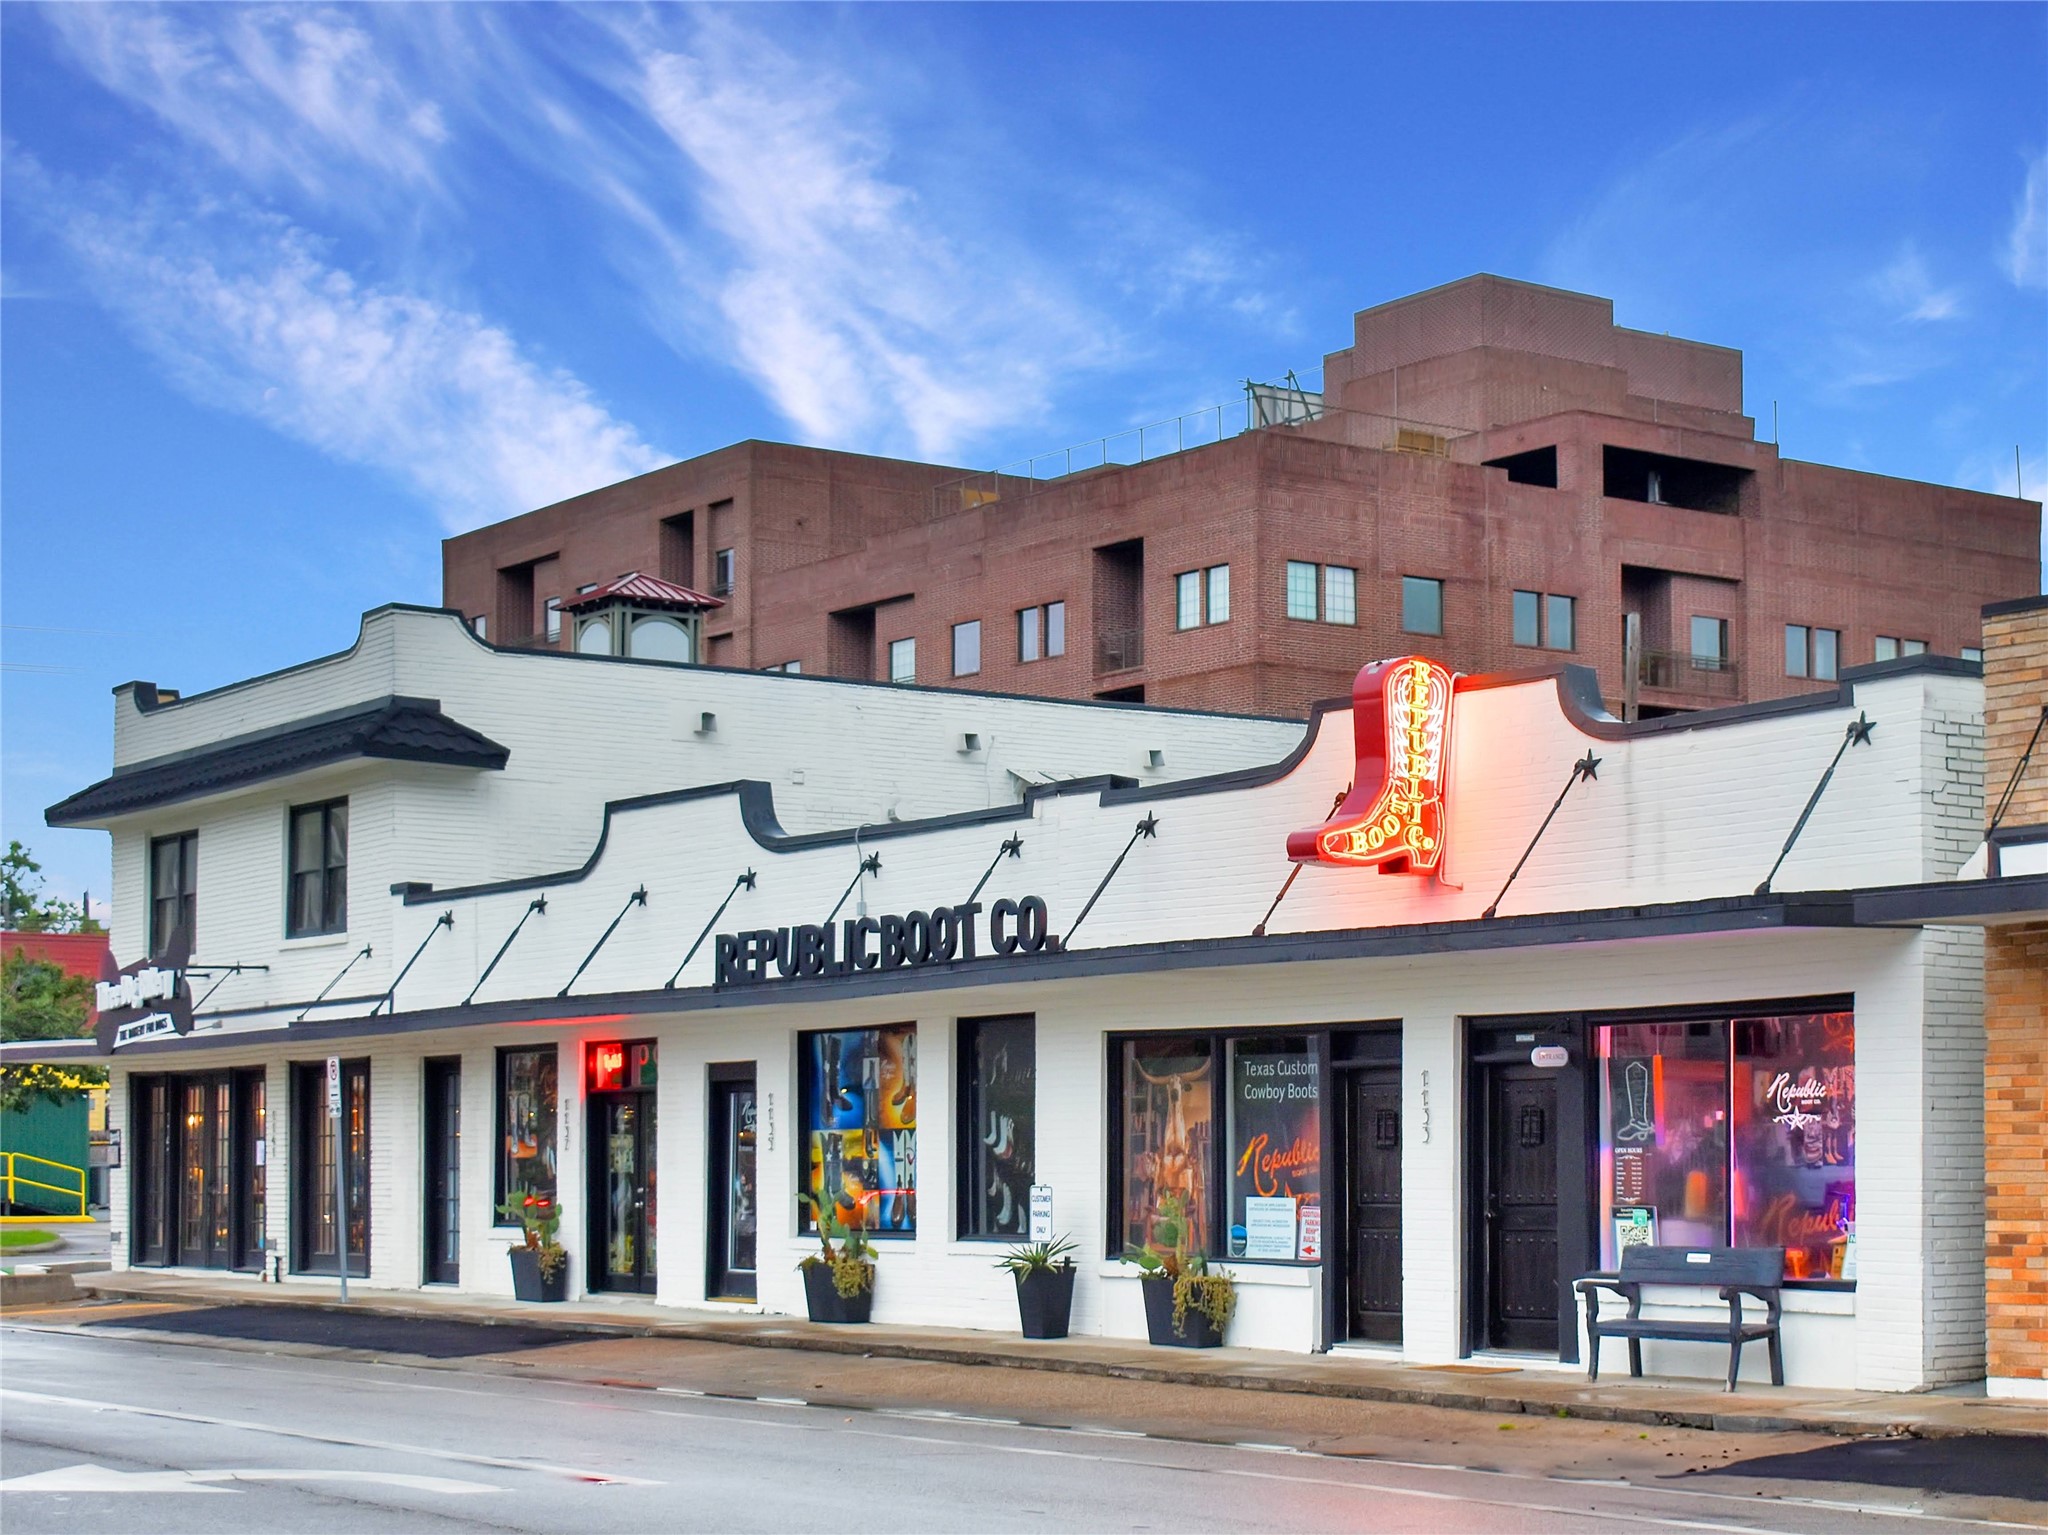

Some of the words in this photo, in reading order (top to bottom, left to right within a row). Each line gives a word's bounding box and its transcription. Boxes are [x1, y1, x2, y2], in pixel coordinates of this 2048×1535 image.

[1407, 659, 1431, 825] REPUBLIC
[1349, 793, 1409, 853] BOOT
[991, 895, 1059, 955] CO.
[1244, 1061, 1275, 1076] Texas
[1277, 1060, 1319, 1076] Custom
[1244, 1083, 1286, 1104] Cowboy
[1288, 1083, 1319, 1099] Boots
[1766, 1072, 1827, 1113] Republic
[1031, 1195, 1051, 1203] CUSTOMER
[1032, 1210, 1050, 1218] PARKING
[1036, 1226, 1046, 1234] ONLY
